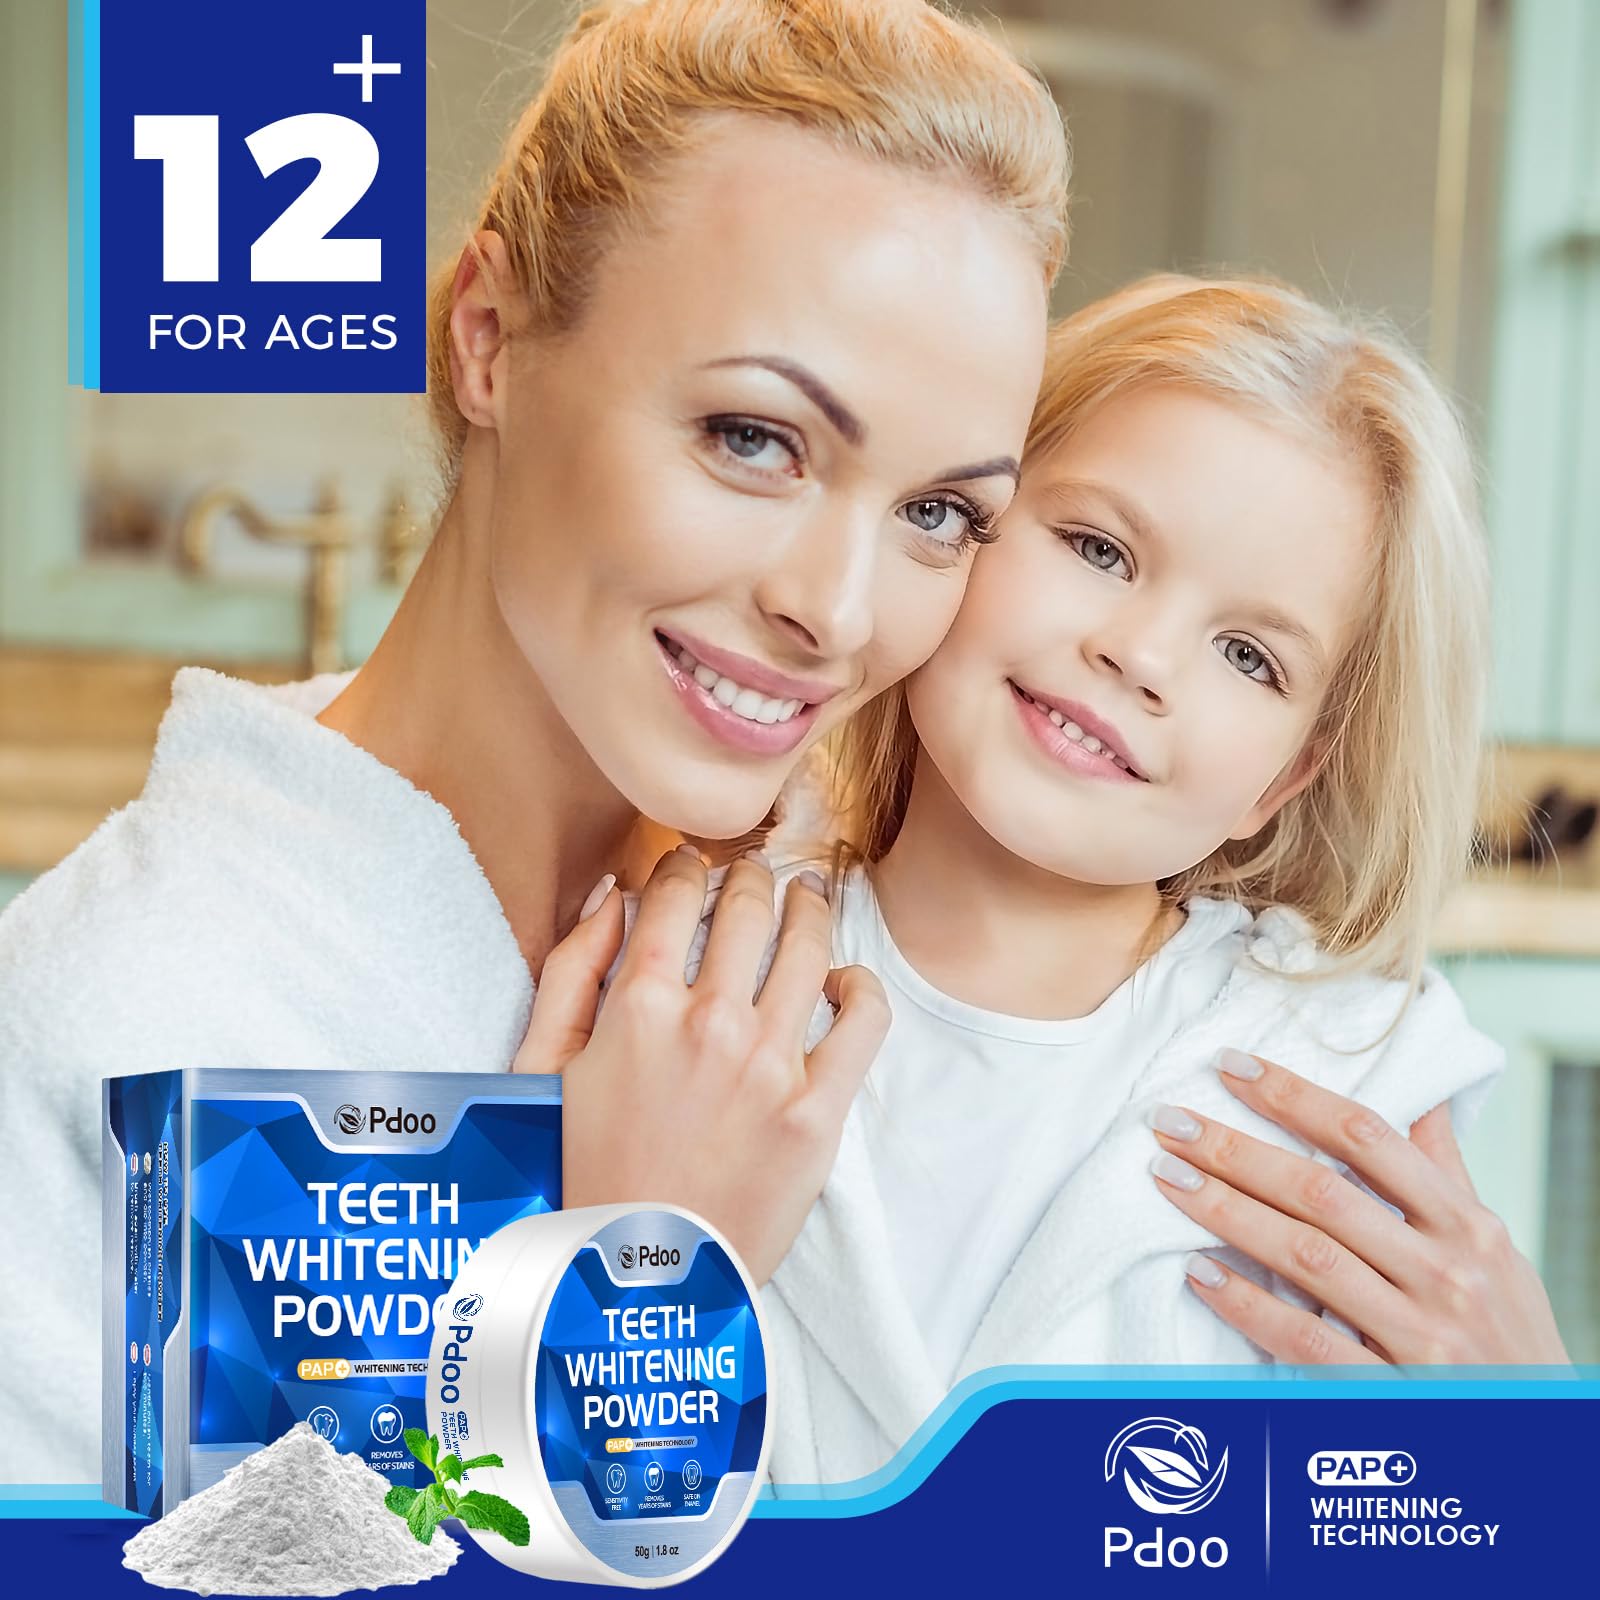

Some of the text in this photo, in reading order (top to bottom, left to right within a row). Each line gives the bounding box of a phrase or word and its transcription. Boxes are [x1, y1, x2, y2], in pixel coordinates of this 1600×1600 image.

[370, 1107, 437, 1134] Pdoo
[308, 1183, 459, 1225] TEETH
[242, 1237, 487, 1281] WHITENIN
[639, 1245, 681, 1268] Pdoo
[602, 1304, 697, 1342] TEETH
[354, 1363, 429, 1374] WHITENING TECH
[440, 1325, 474, 1404] Pdoo
[565, 1346, 736, 1387] WHITENING
[449, 1412, 457, 1439] TEETH
[584, 1390, 719, 1430] POWDER
[441, 1411, 452, 1450] POWDER
[371, 1451, 404, 1459] REMOVES
[635, 1545, 679, 1559] 50g 1.8 oz
